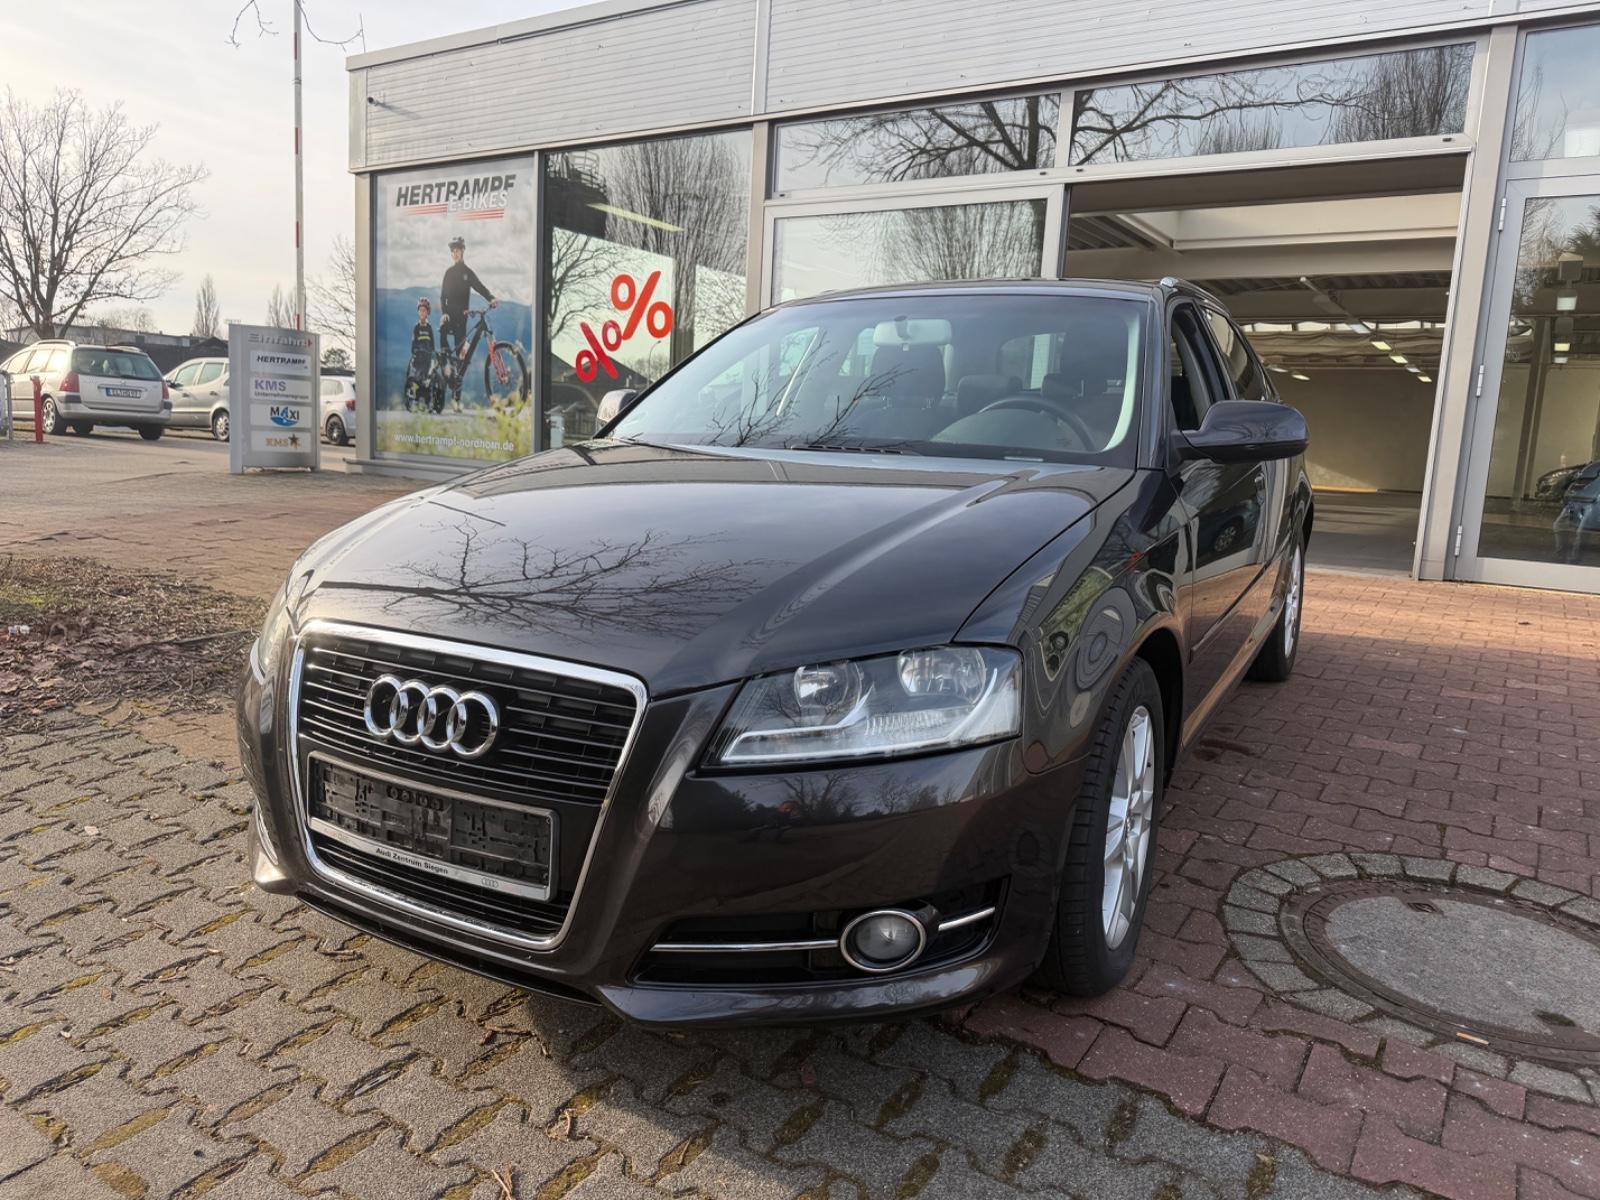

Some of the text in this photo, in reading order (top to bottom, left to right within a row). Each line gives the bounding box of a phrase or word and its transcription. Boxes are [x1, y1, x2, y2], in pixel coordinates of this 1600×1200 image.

[396, 174, 517, 207] HERTRAMPF
[256, 355, 306, 365] HERTRAMPF
[254, 379, 287, 392] KMS
[270, 406, 300, 421] MAXI
[376, 847, 449, 875] Audi Zentrum Siegen
